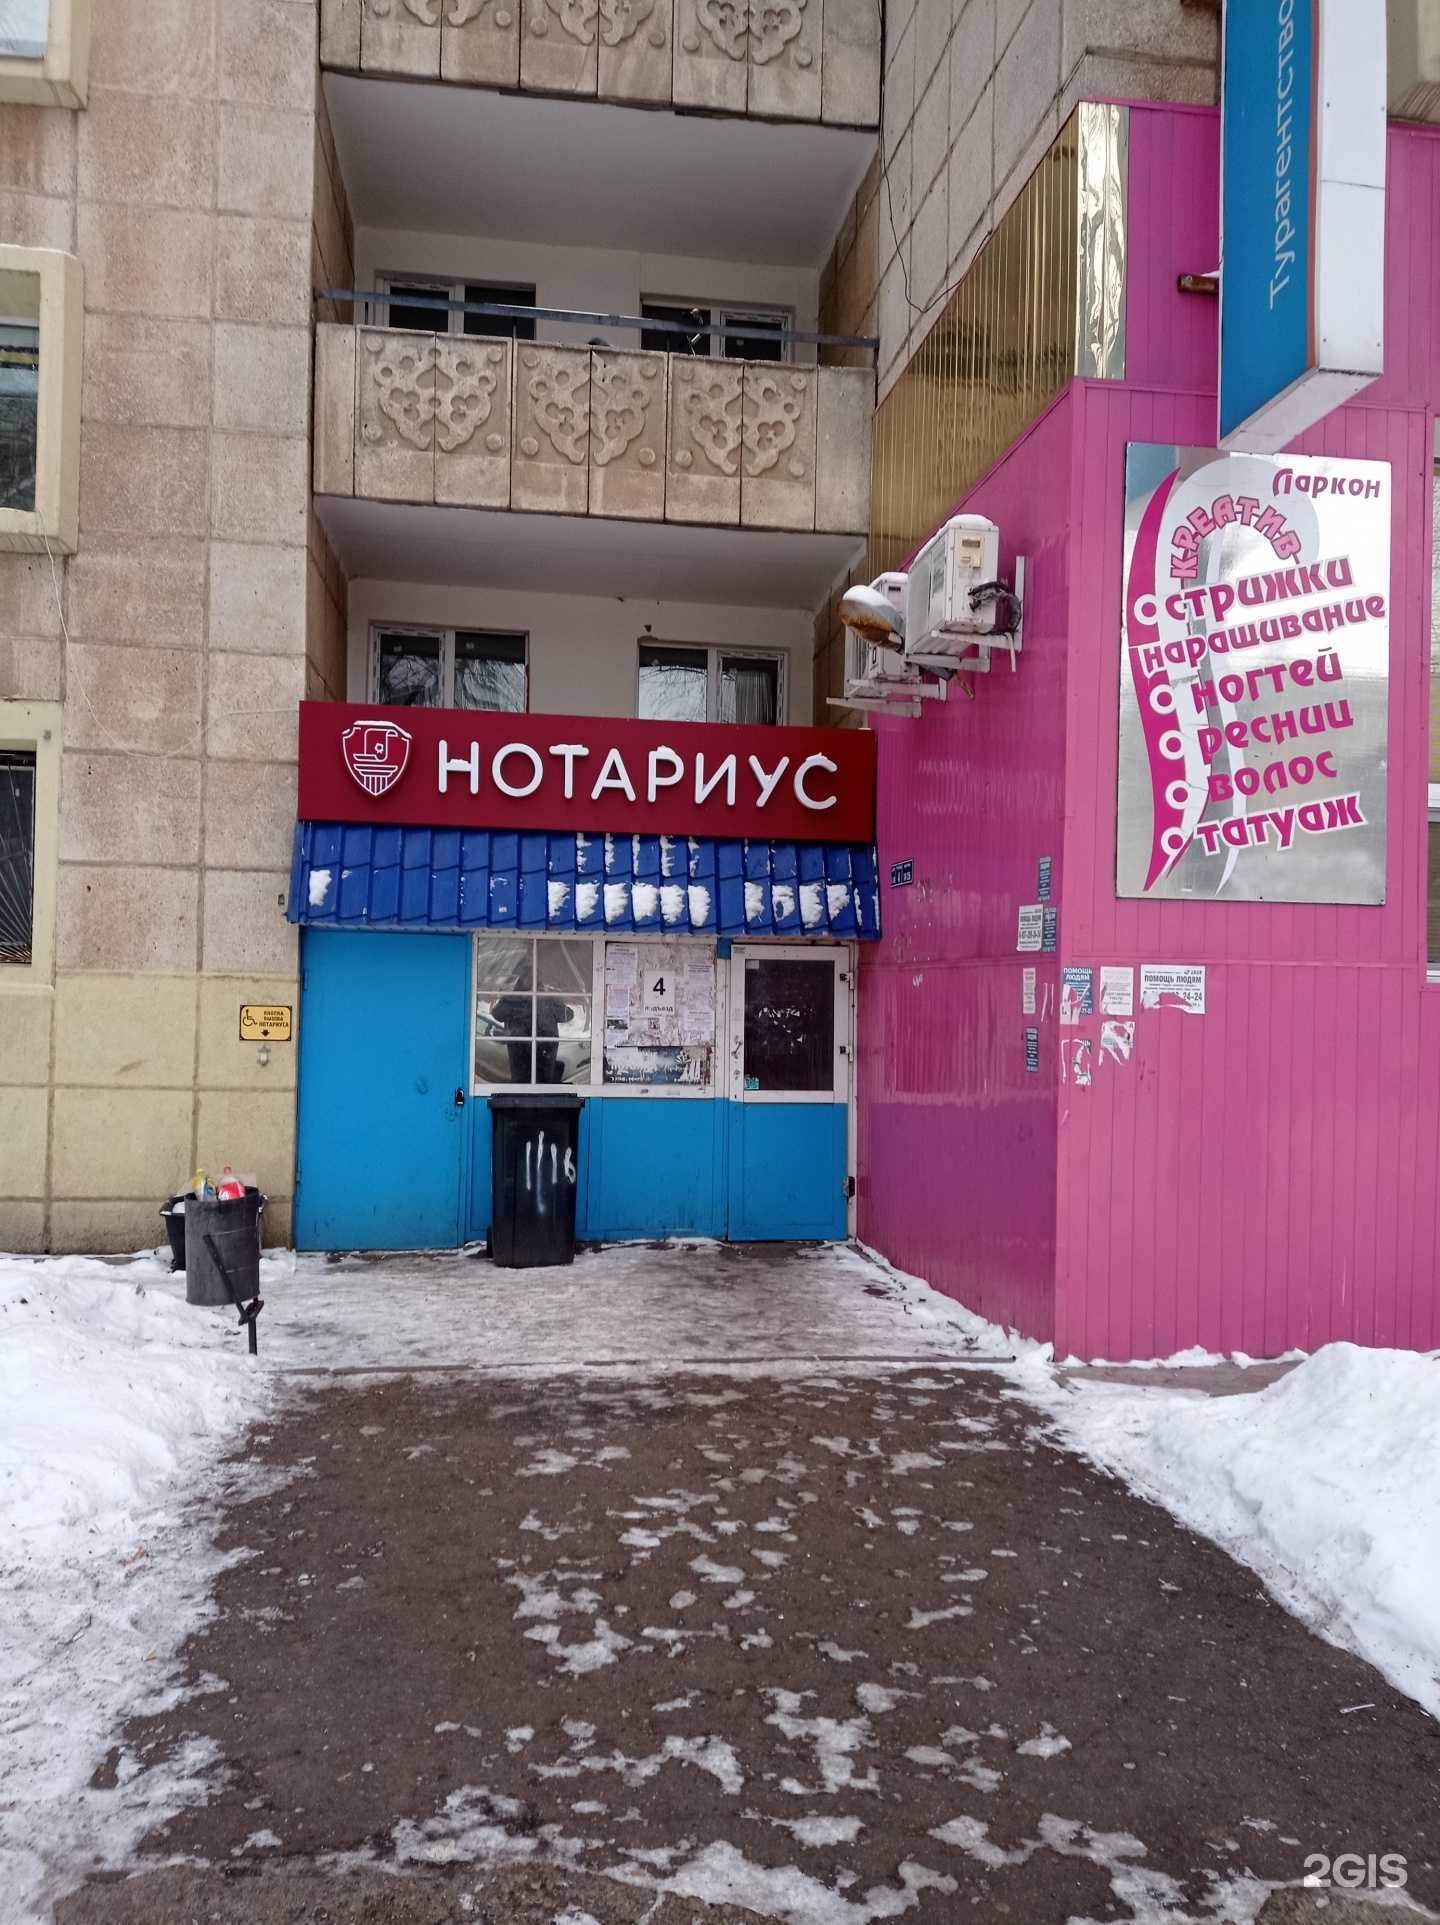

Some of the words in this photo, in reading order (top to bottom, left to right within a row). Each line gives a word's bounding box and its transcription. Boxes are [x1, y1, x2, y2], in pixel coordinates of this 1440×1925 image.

[1269, 0, 1295, 310] Турагентство
[1170, 494, 1302, 580] КРЕАТИВ
[1165, 558, 1353, 622] стрижки
[1143, 595, 1386, 674] наращивание
[1191, 646, 1343, 714] ногтей
[1197, 699, 1354, 765] ресниц
[438, 739, 838, 811] НОТАРИУС
[1207, 751, 1337, 802] волос
[1196, 796, 1364, 853] татуаж
[653, 977, 666, 996] 4
[1144, 975, 1174, 983] ПОМОЩЬ
[1176, 976, 1202, 984] ЛЮДЯМ
